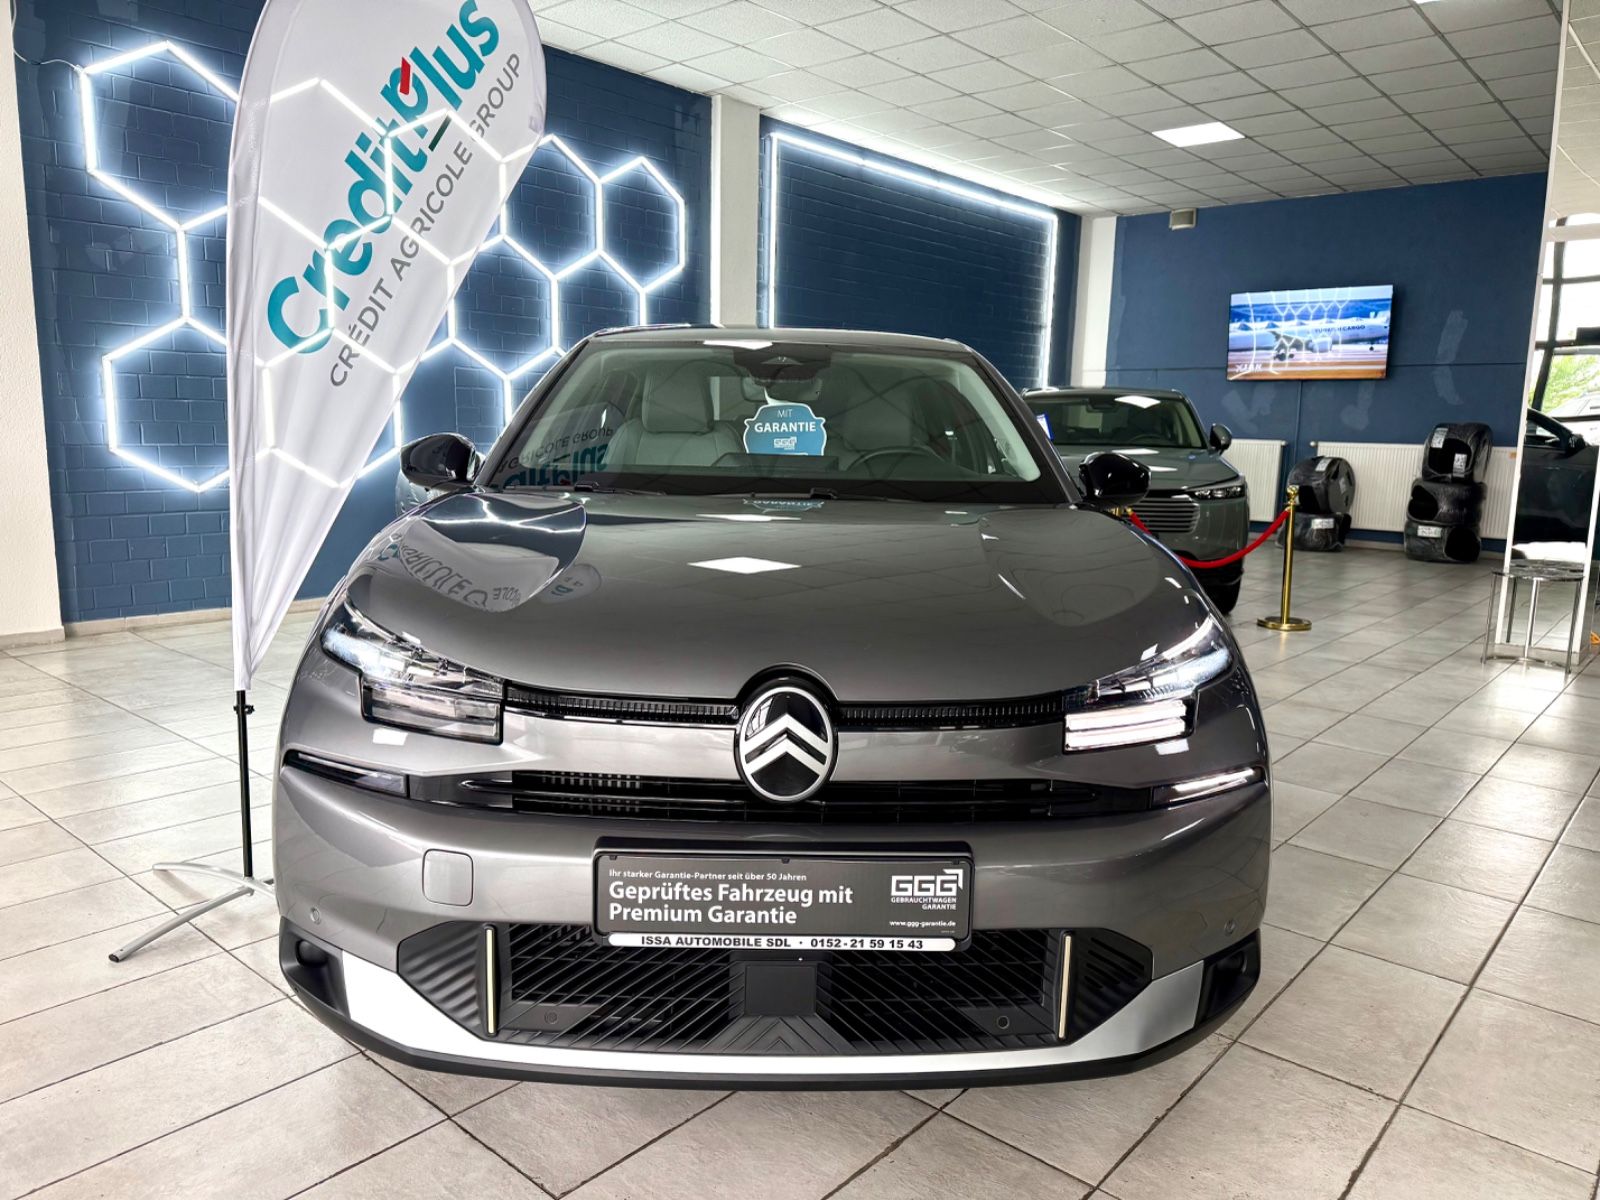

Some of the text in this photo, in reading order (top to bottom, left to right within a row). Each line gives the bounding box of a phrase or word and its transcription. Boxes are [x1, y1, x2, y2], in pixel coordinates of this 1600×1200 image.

[266, 0, 500, 355] Creditplus
[330, 53, 521, 388] CRÉDIT AGRICOLE GROUP
[777, 409, 793, 418] MIT
[754, 421, 816, 433] GARANTIE
[609, 869, 807, 881] Ihr starker Garantie-Partner seit über 50 Jahren
[891, 875, 958, 896] GGG
[609, 881, 854, 908] Geprüftes Fahrzeug mit
[609, 903, 798, 924] Premium Garantie
[889, 920, 956, 928] www.ggg-garantie.de
[641, 936, 672, 945] ISSA
[676, 937, 762, 947] AUTOMOBILE
[766, 938, 791, 948] SDL
[869, 939, 885, 949] 59
[889, 939, 904, 949] 15
[908, 939, 923, 949] 43
